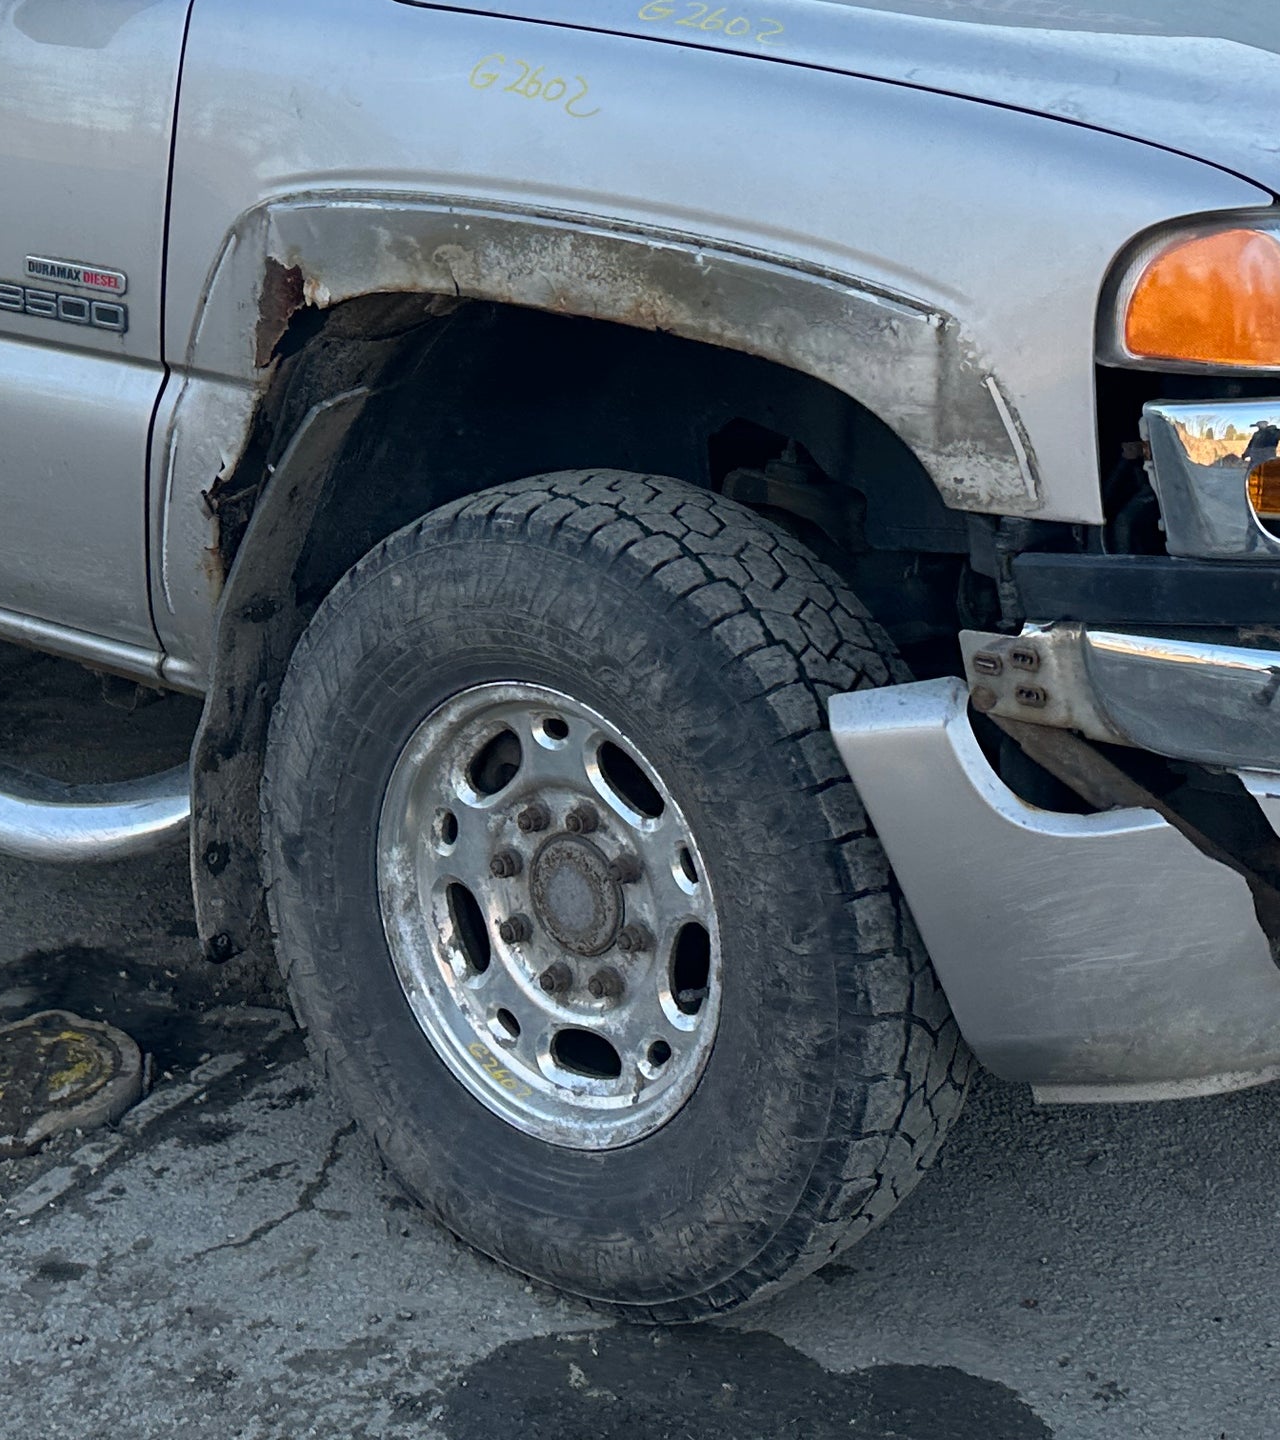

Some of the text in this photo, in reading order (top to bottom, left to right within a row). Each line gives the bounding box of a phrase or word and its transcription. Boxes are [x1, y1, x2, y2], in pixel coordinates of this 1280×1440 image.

[469, 54, 601, 118] G2602
[27, 259, 120, 289] DURAMAX DIESEL
